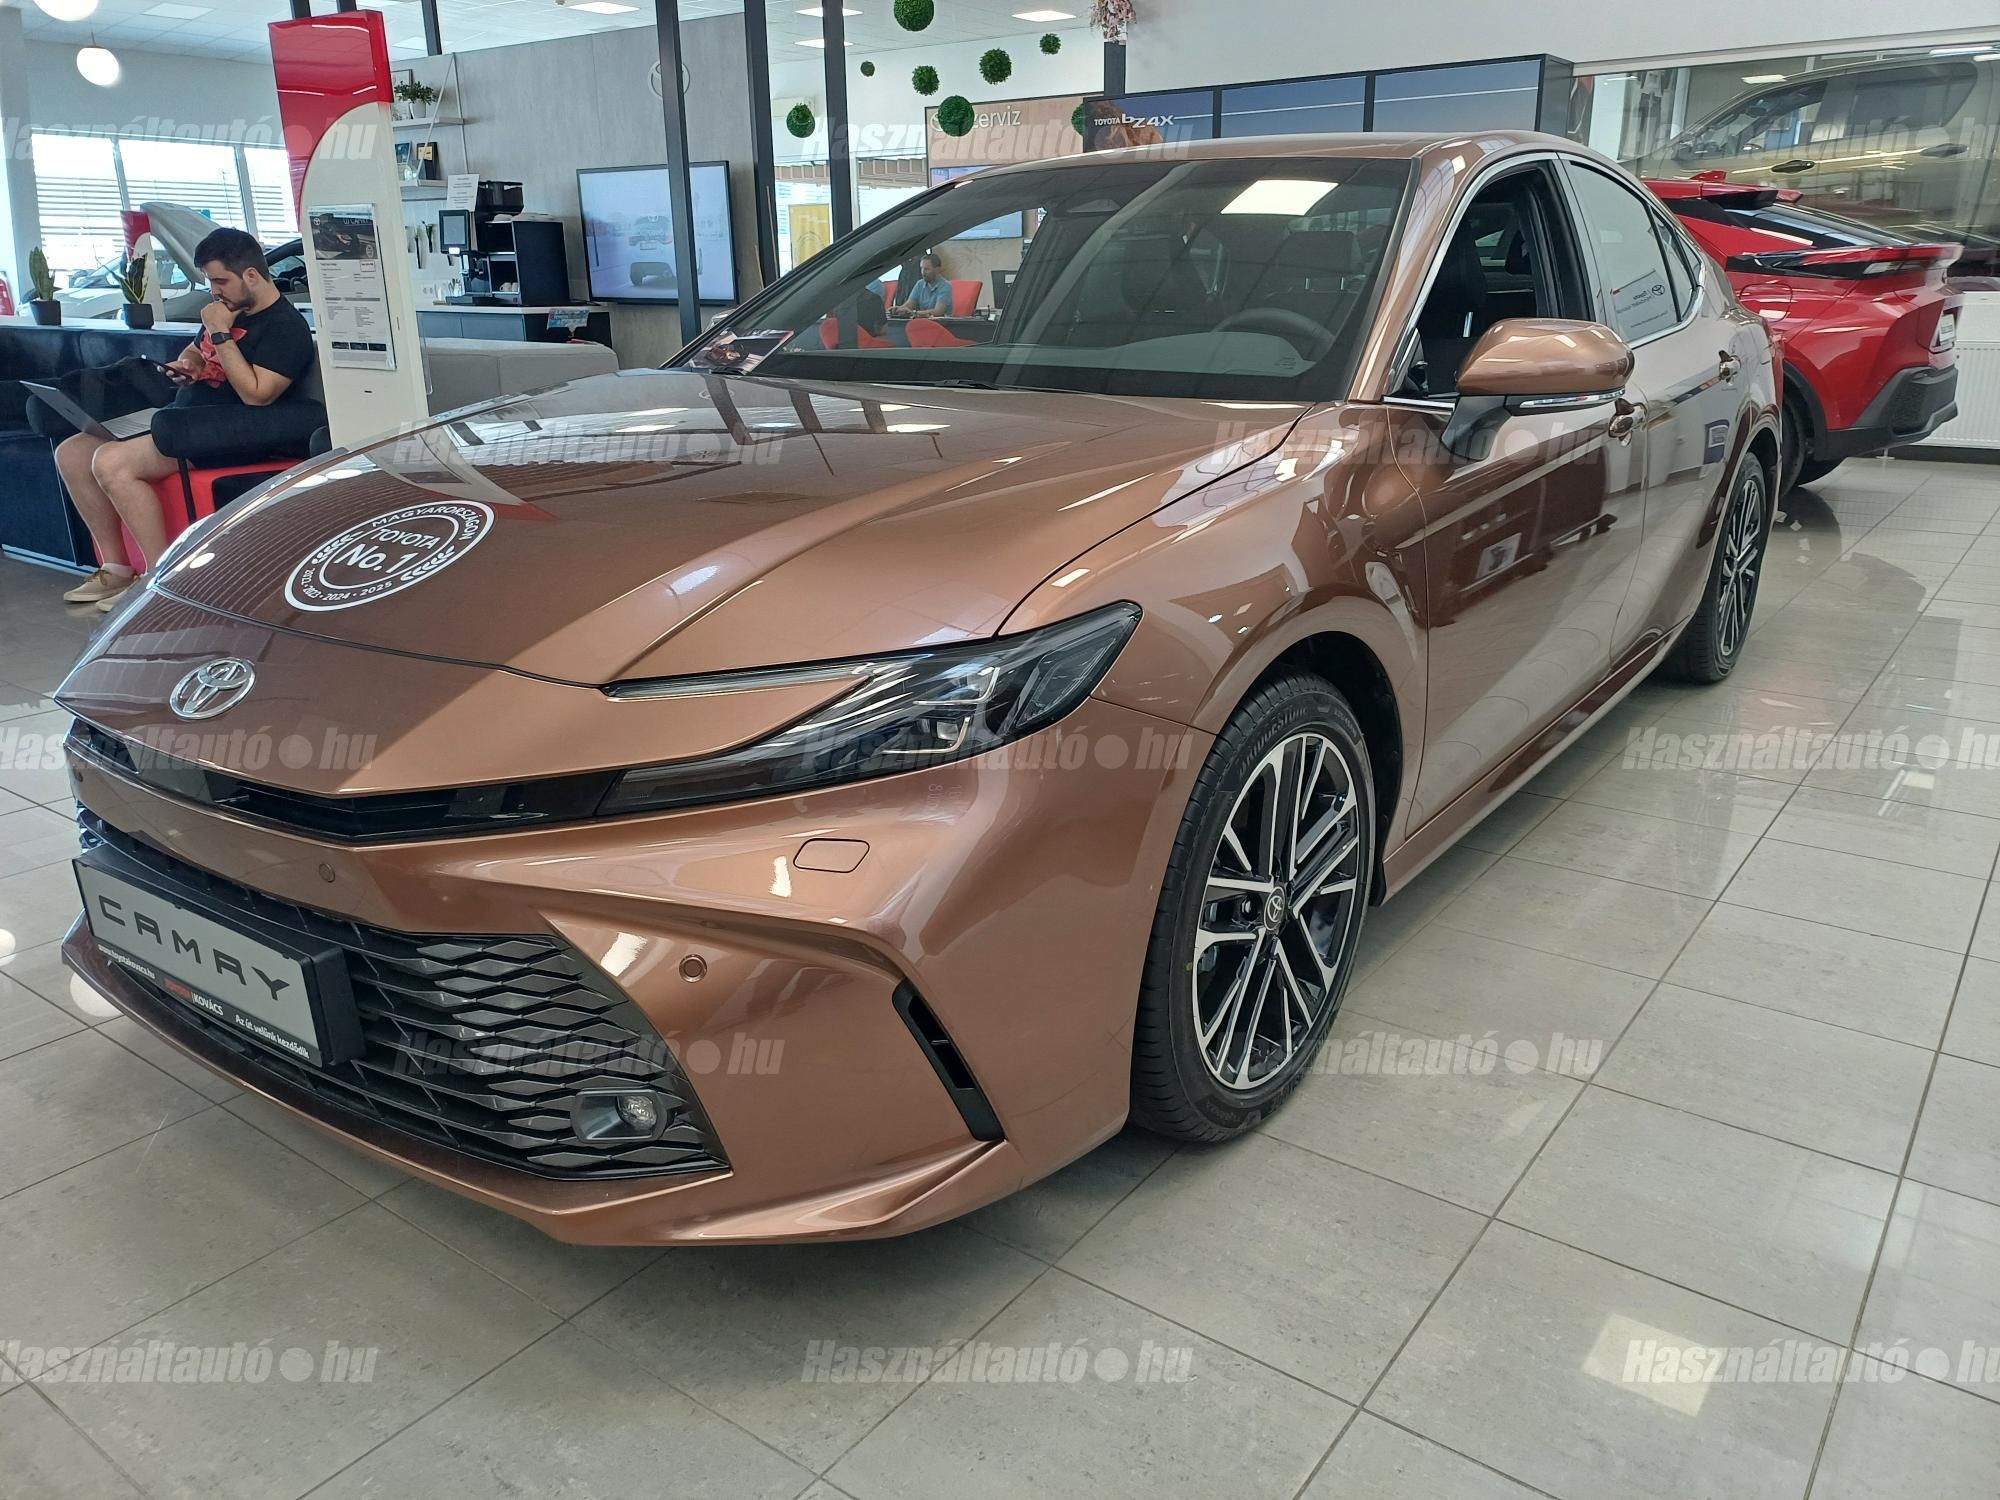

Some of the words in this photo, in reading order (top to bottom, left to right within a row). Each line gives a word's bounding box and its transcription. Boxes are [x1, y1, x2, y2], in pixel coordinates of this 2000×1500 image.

[973, 105, 1021, 129] zerviz
[1094, 117, 1120, 126] TOYOTA
[372, 506, 482, 541] MAGYARORSZÁGON
[370, 528, 441, 550] TOYOTA
[322, 592, 351, 601] 2024
[360, 581, 393, 597] 2025
[98, 894, 291, 1001] CAMRY
